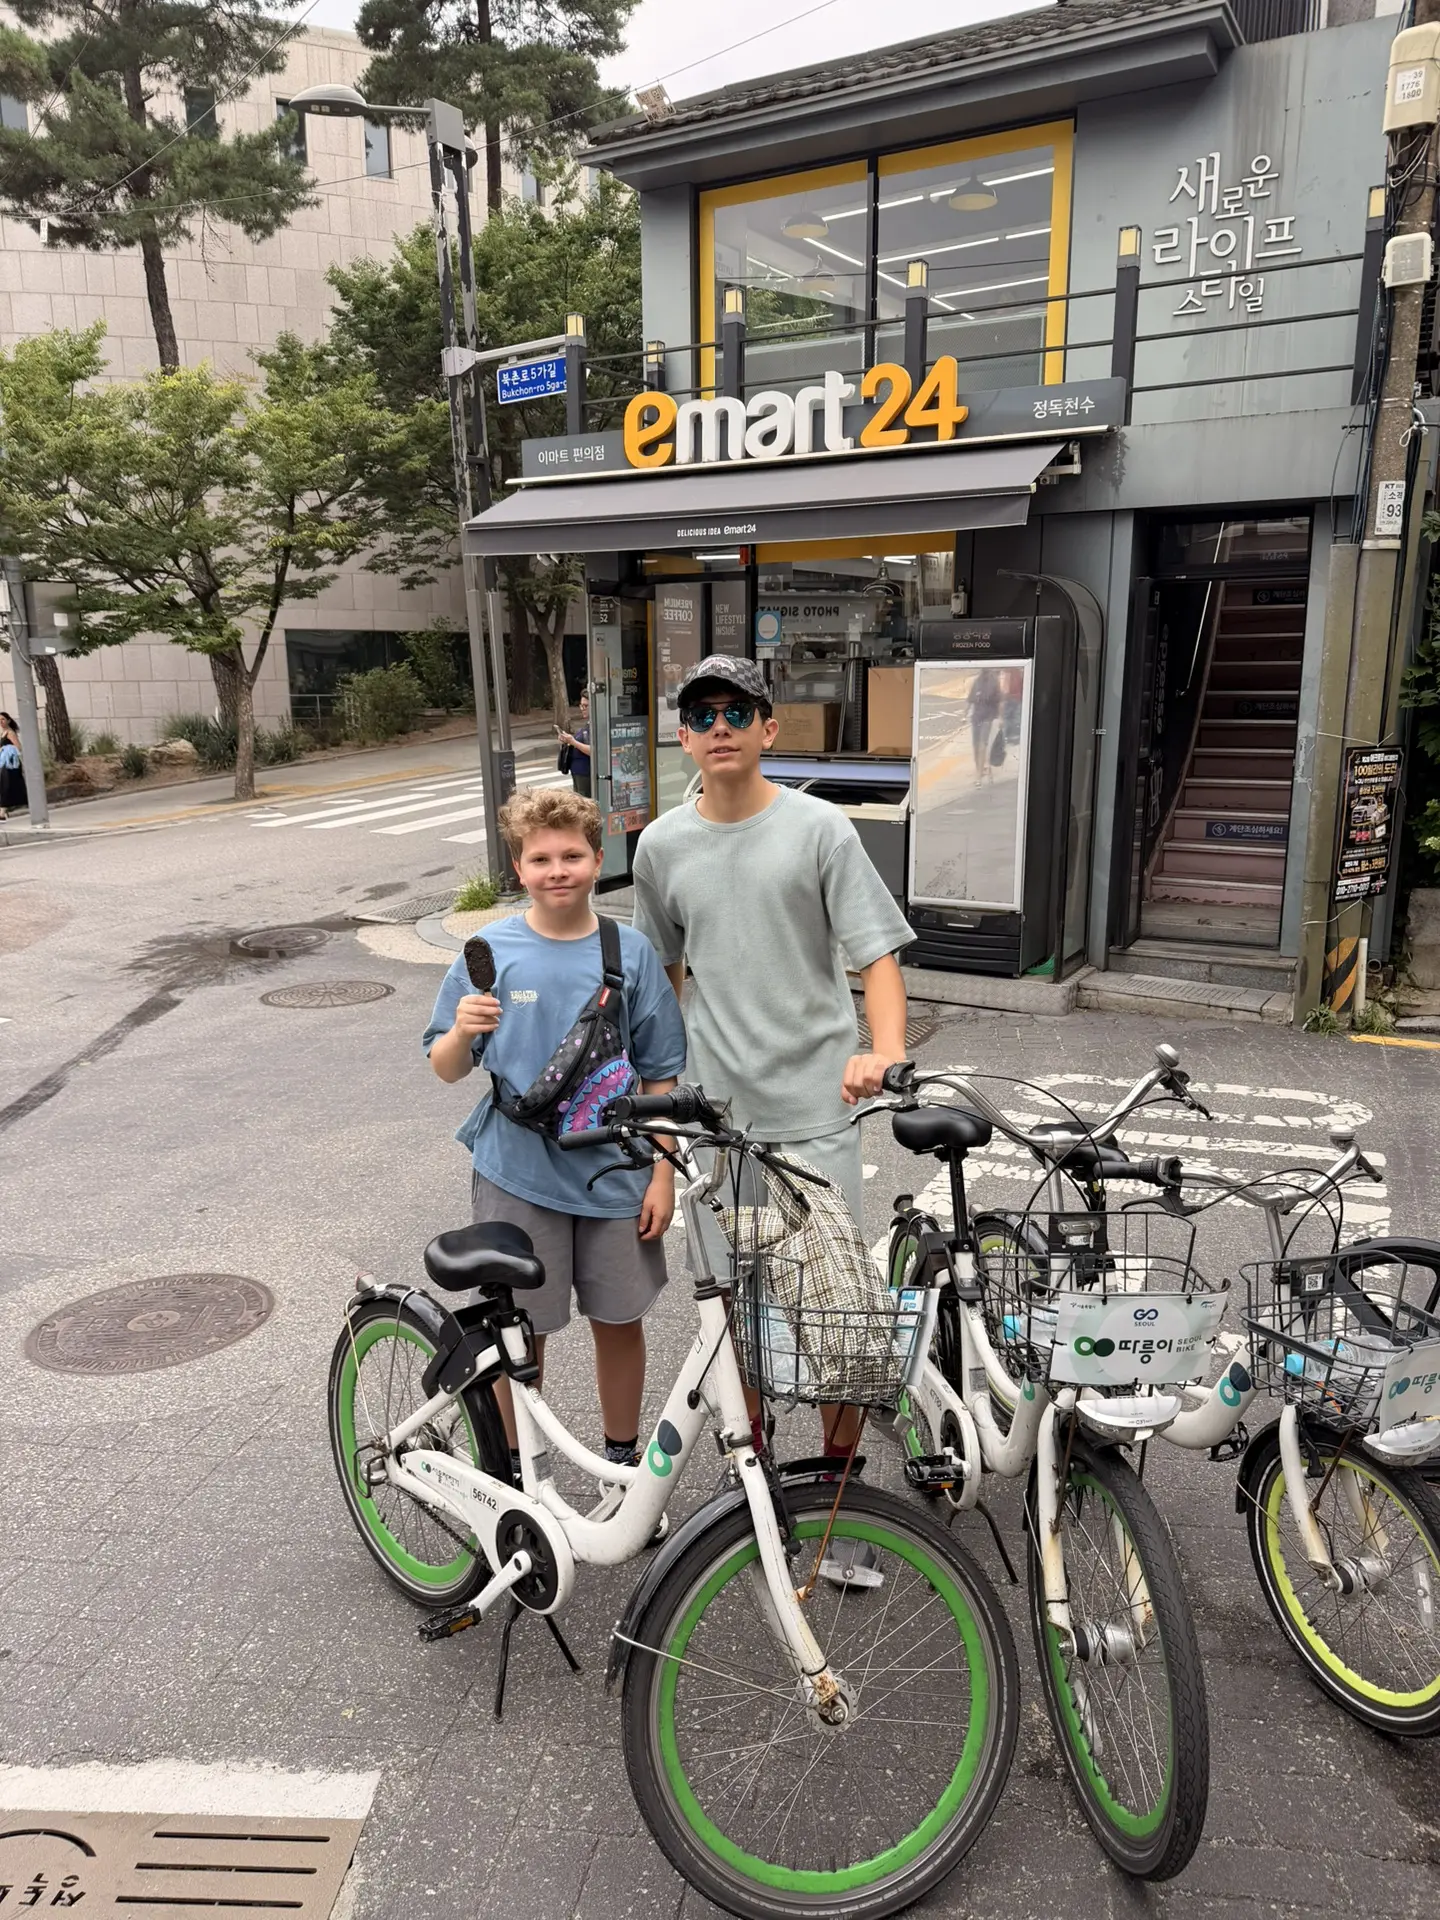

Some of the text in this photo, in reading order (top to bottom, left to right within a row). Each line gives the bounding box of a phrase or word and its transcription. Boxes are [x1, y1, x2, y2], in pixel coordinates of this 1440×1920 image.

[1169, 151, 1280, 220] 새로운
[1152, 215, 1303, 279] 라이프
[1172, 259, 1266, 316] 스타일
[501, 361, 557, 387] 북촌로5가길
[501, 384, 546, 399] Bukchon-ro
[624, 355, 969, 469] emart24
[1032, 395, 1096, 419] 정독천수
[538, 444, 605, 465] 이마트 편의점
[1386, 503, 1402, 517] 93
[676, 523, 757, 537] DELICIOUS IDEA emart24
[715, 603, 730, 614] NEW
[952, 641, 991, 649] FROZEN FOOD
[1118, 1335, 1203, 1365] 따릉이 SEOUL
[1176, 1345, 1196, 1353] BIKE
[1411, 1372, 1440, 1394] 따릉
[472, 1487, 497, 1511] 56742
